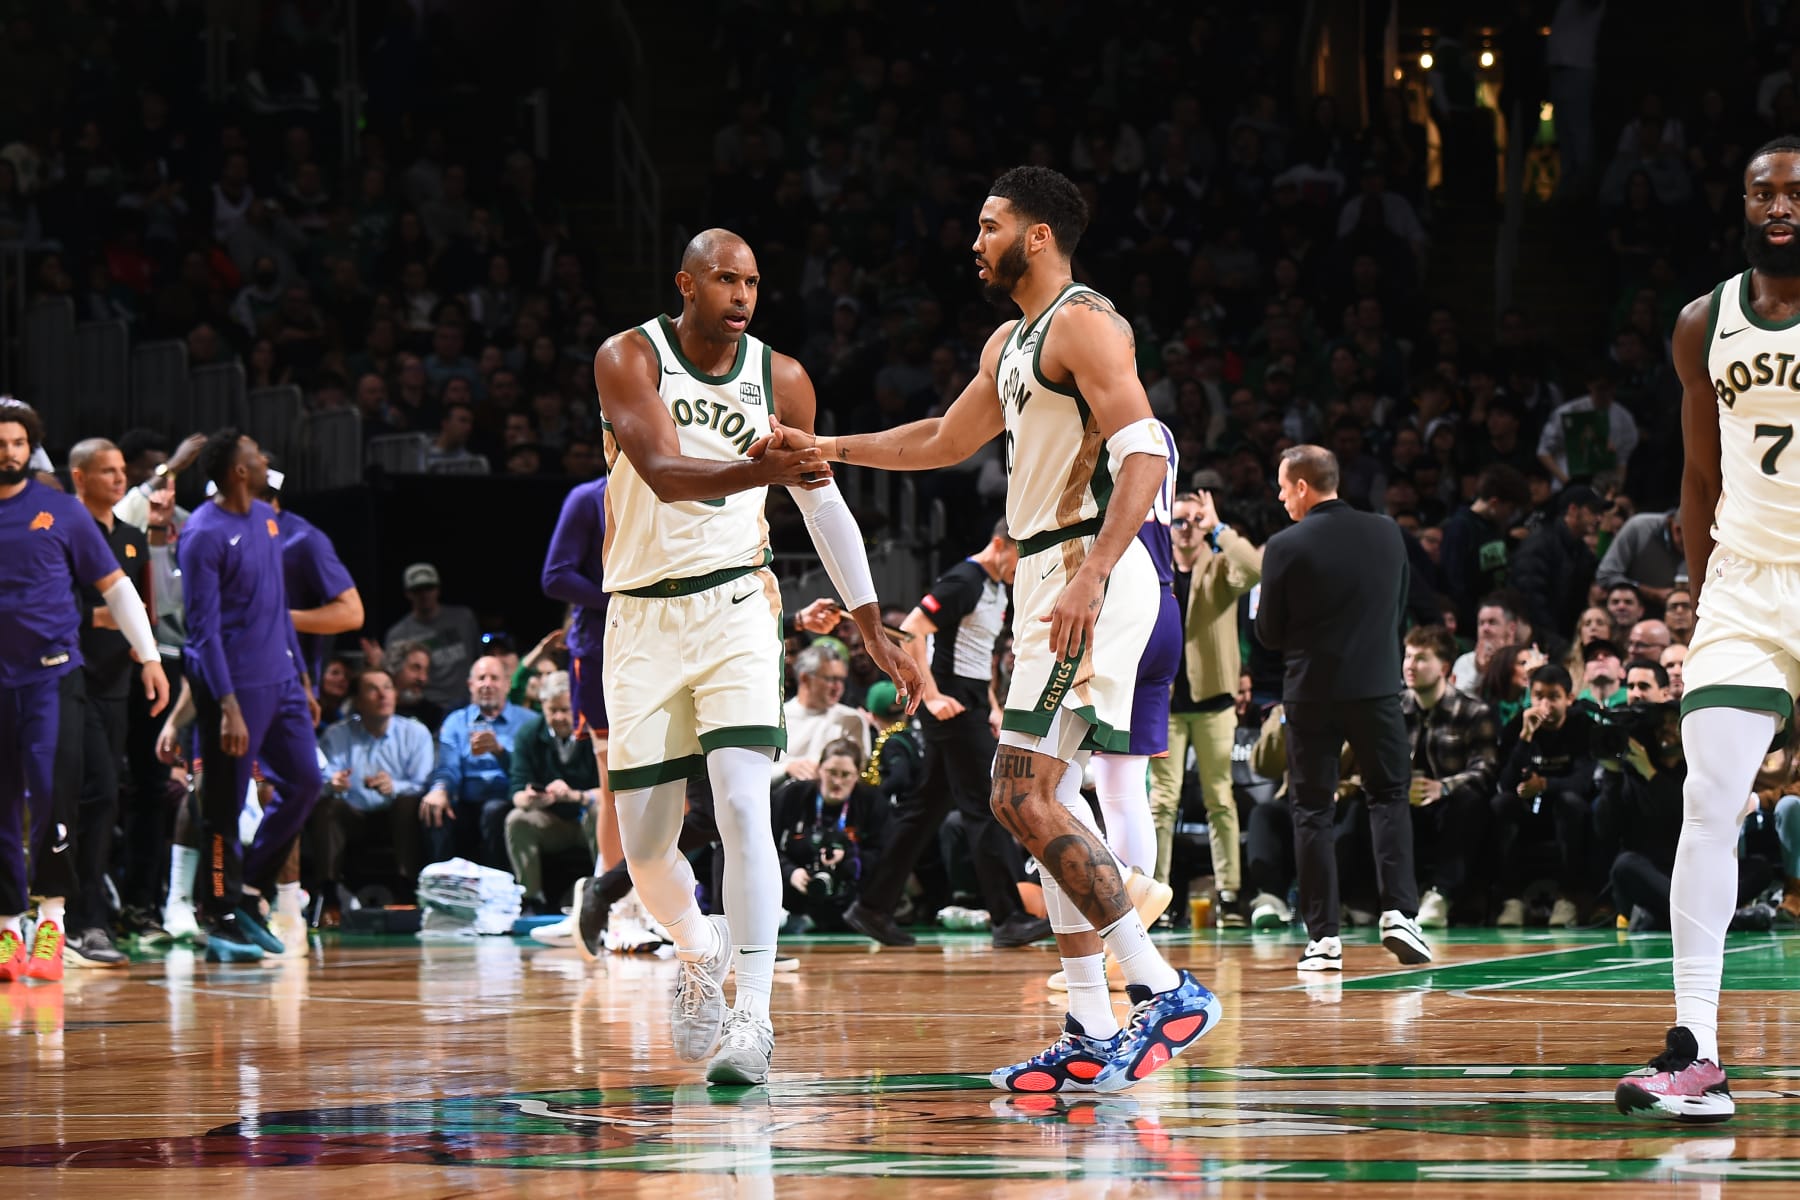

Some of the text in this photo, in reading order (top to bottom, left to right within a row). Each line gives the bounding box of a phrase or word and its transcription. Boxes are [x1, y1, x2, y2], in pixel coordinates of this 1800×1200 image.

[671, 398, 760, 455] OSTON
[1753, 423, 1794, 476] 7
[1043, 662, 1073, 711] CELTICS
